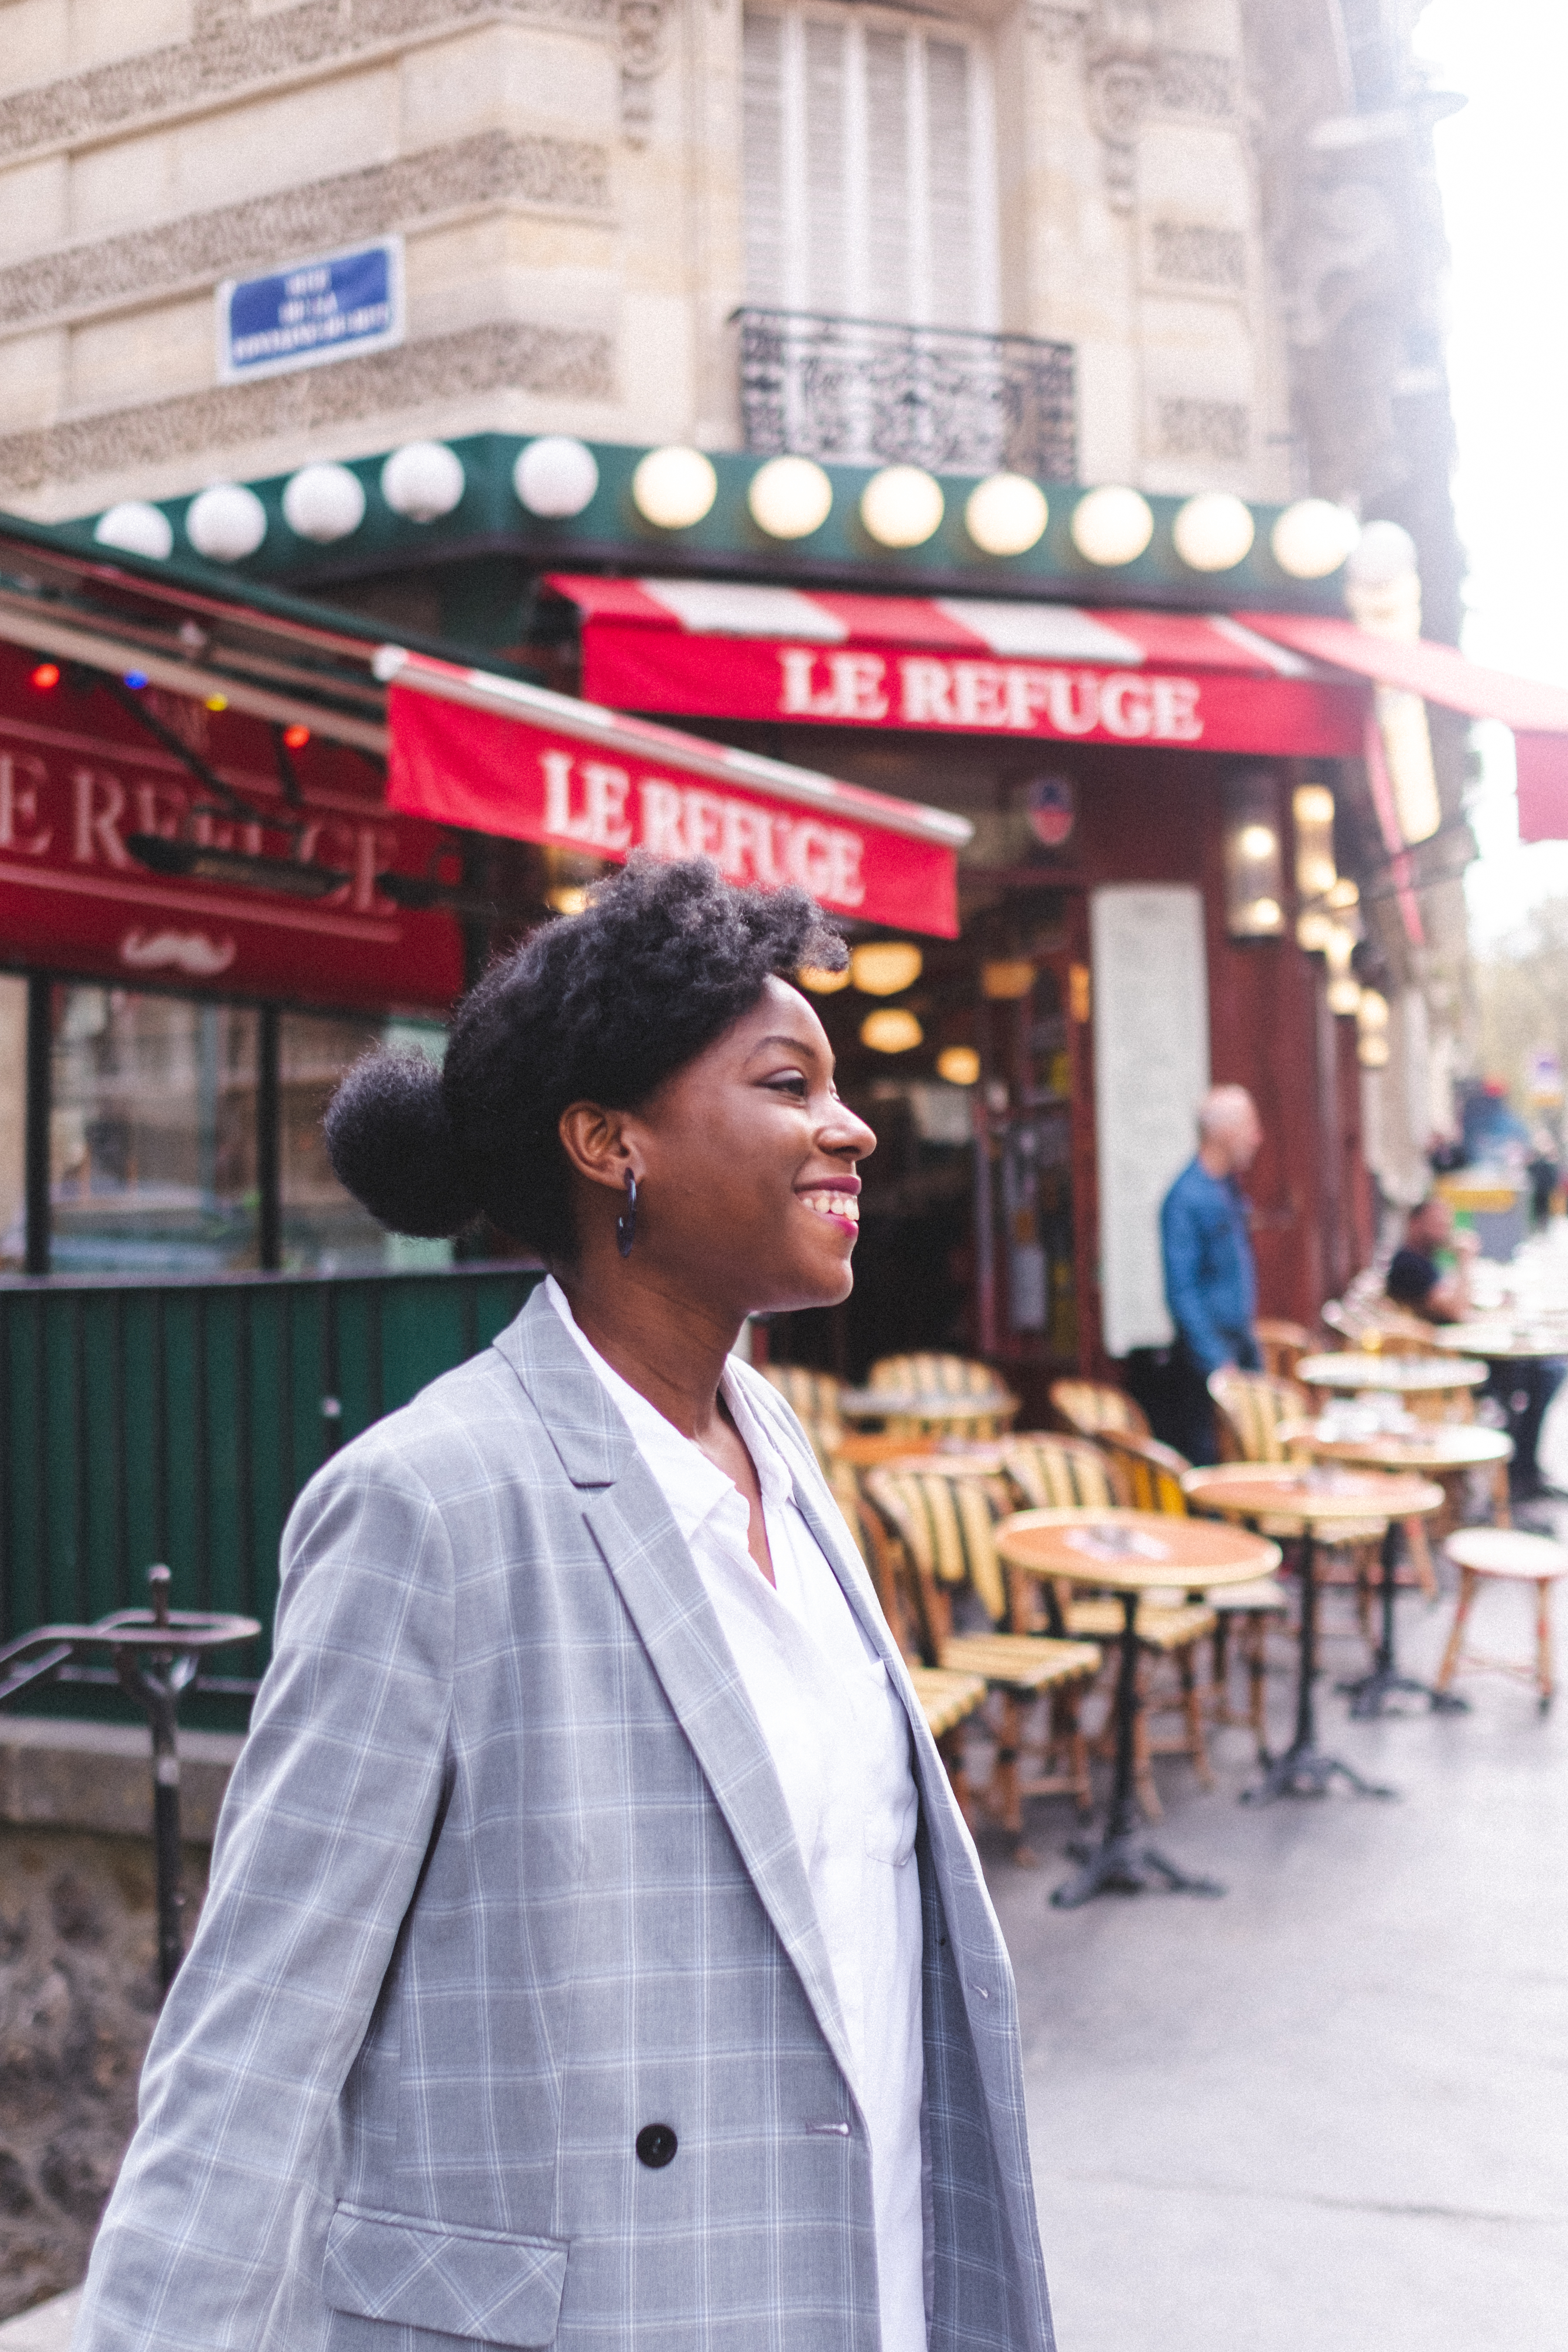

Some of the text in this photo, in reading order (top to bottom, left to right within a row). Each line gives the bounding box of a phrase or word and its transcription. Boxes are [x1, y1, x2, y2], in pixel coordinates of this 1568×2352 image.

[781, 649, 1204, 741] LE REFUGE
[540, 750, 867, 907] LE REFUGE
